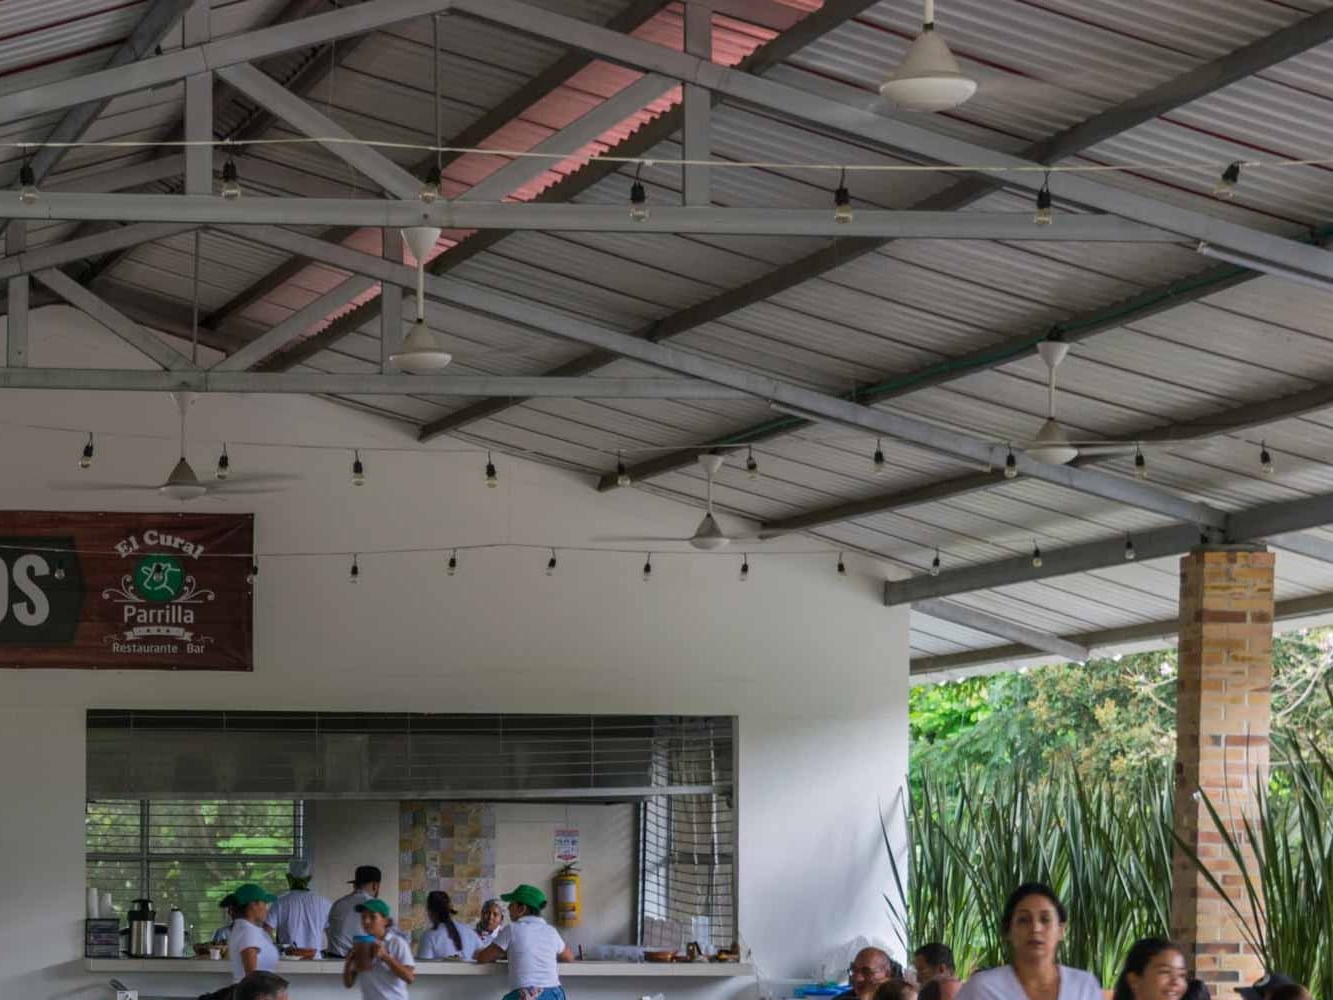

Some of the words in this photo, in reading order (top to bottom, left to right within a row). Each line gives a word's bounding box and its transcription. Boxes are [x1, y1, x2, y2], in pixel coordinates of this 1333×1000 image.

[115, 536, 140, 558] El
[143, 530, 204, 559] Cural
[124, 605, 194, 623] Parrilla
[113, 642, 178, 654] Restaurante
[187, 643, 205, 654] Bar
